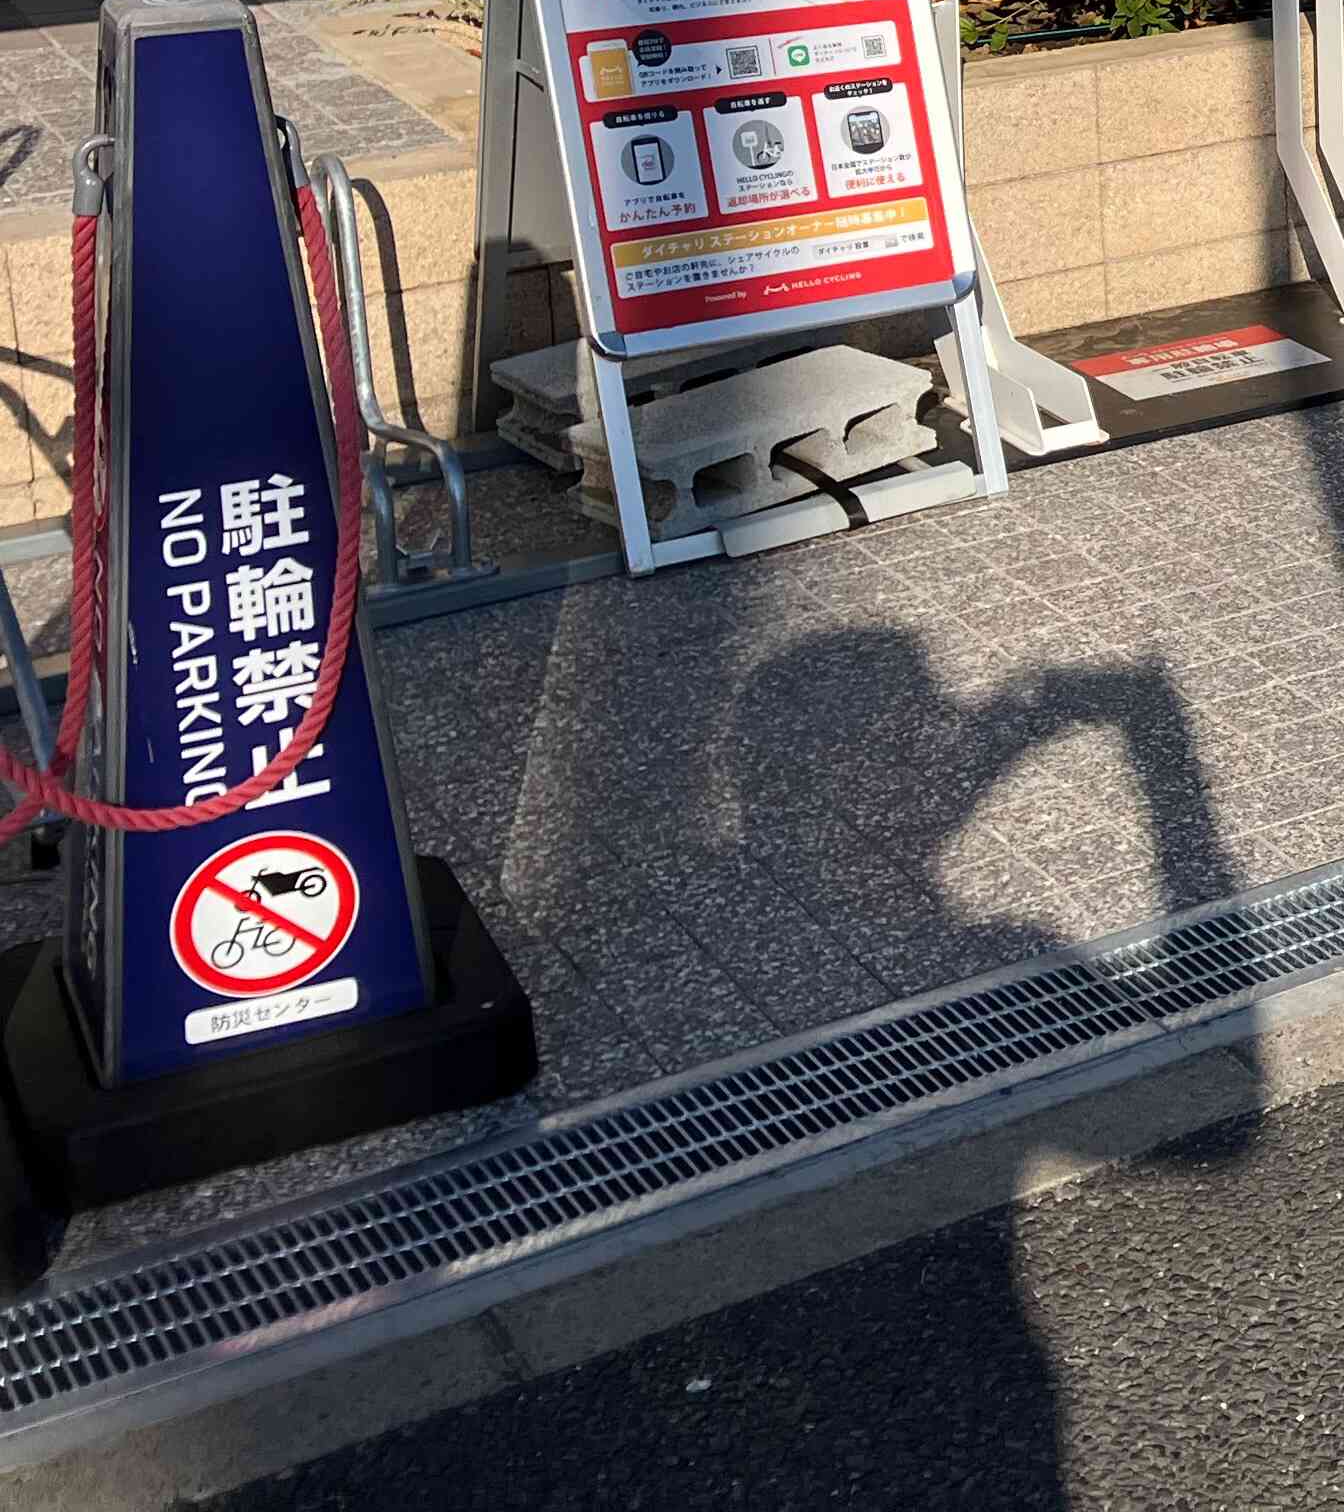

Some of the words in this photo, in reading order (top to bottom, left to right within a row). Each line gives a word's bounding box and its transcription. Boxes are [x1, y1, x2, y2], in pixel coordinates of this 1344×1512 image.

[845, 172, 906, 189] 便利に使える
[620, 202, 696, 223] かんたん予約
[642, 238, 704, 259] ダイチャリ
[791, 276, 821, 289] HELLO
[823, 272, 863, 285] CYCLING
[158, 488, 208, 567] NO
[220, 473, 331, 810] 駐輪禁止
[210, 992, 333, 1034] 防災センター
